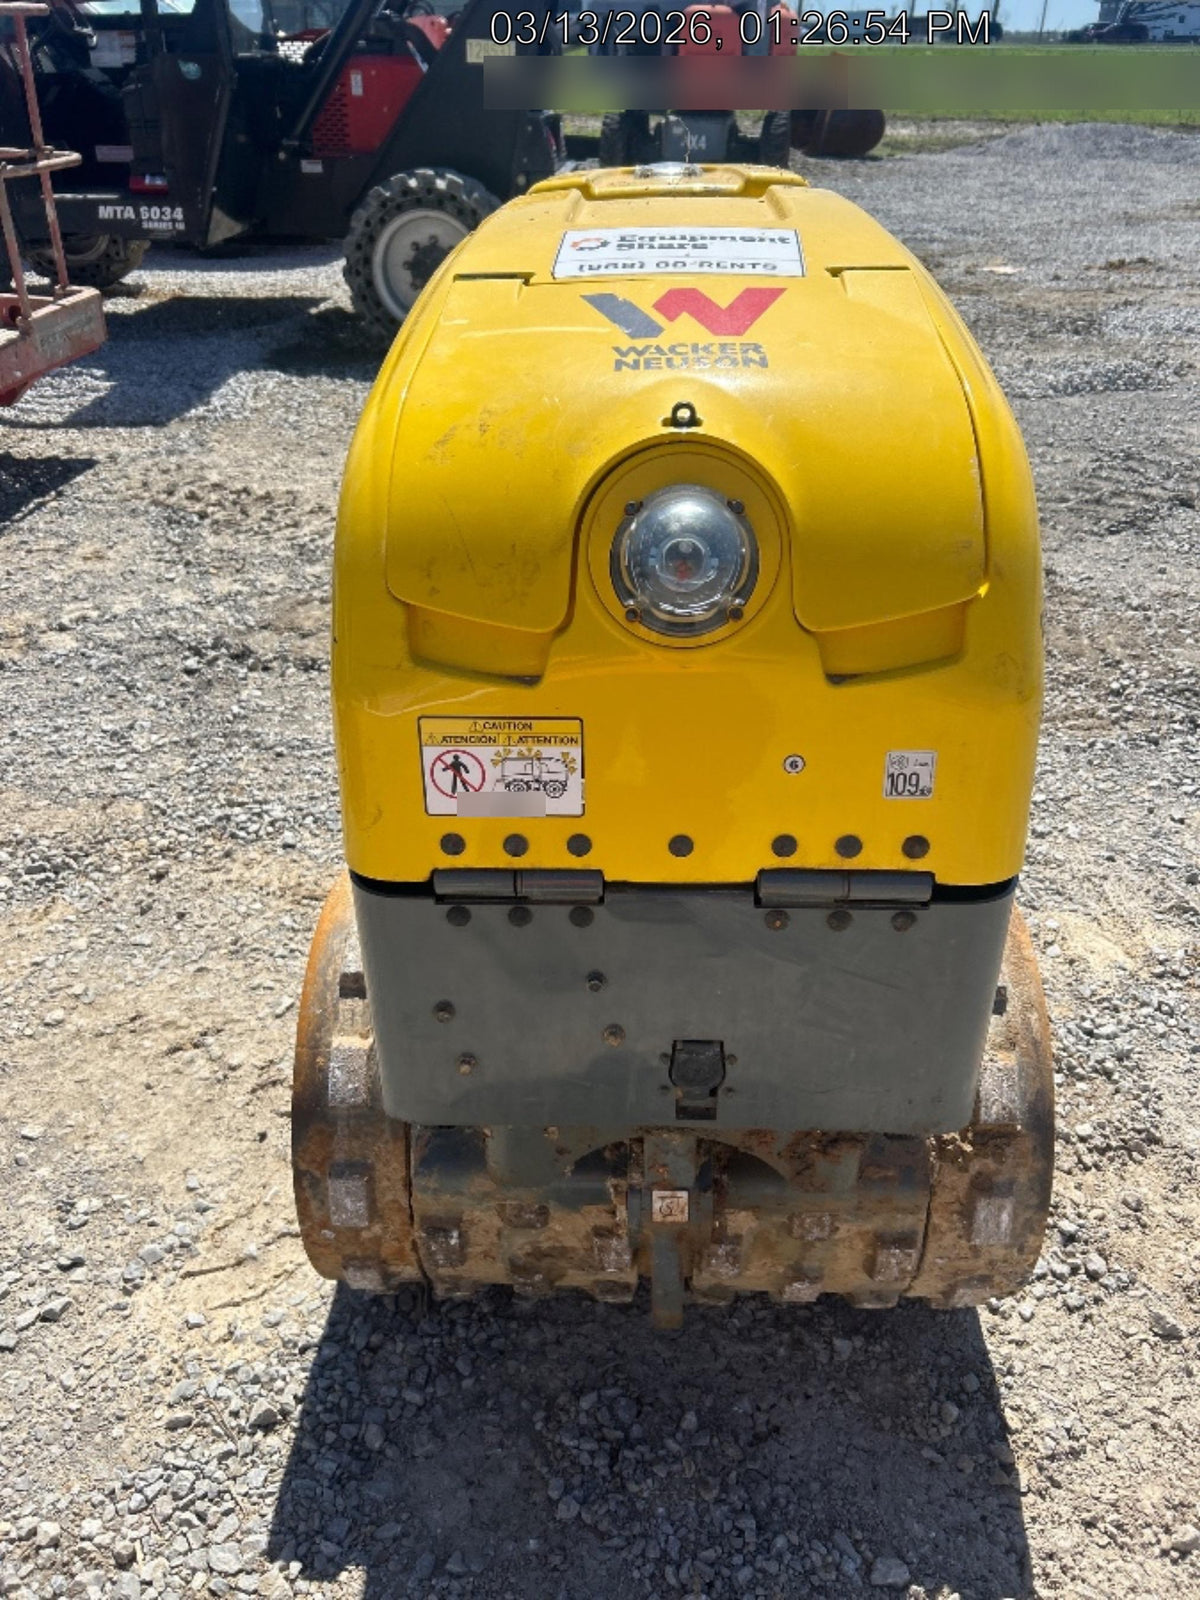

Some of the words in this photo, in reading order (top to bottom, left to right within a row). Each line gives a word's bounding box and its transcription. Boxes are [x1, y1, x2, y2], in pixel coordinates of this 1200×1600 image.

[98, 205, 136, 220] MTA
[139, 205, 184, 221] 6034
[617, 234, 791, 244] Equipment
[616, 242, 709, 251] Share
[612, 342, 765, 358] WACKER
[613, 355, 769, 372] NEUSON
[482, 721, 533, 731] CAUTION
[516, 734, 579, 745] ATTENTION
[888, 772, 920, 796] 109
